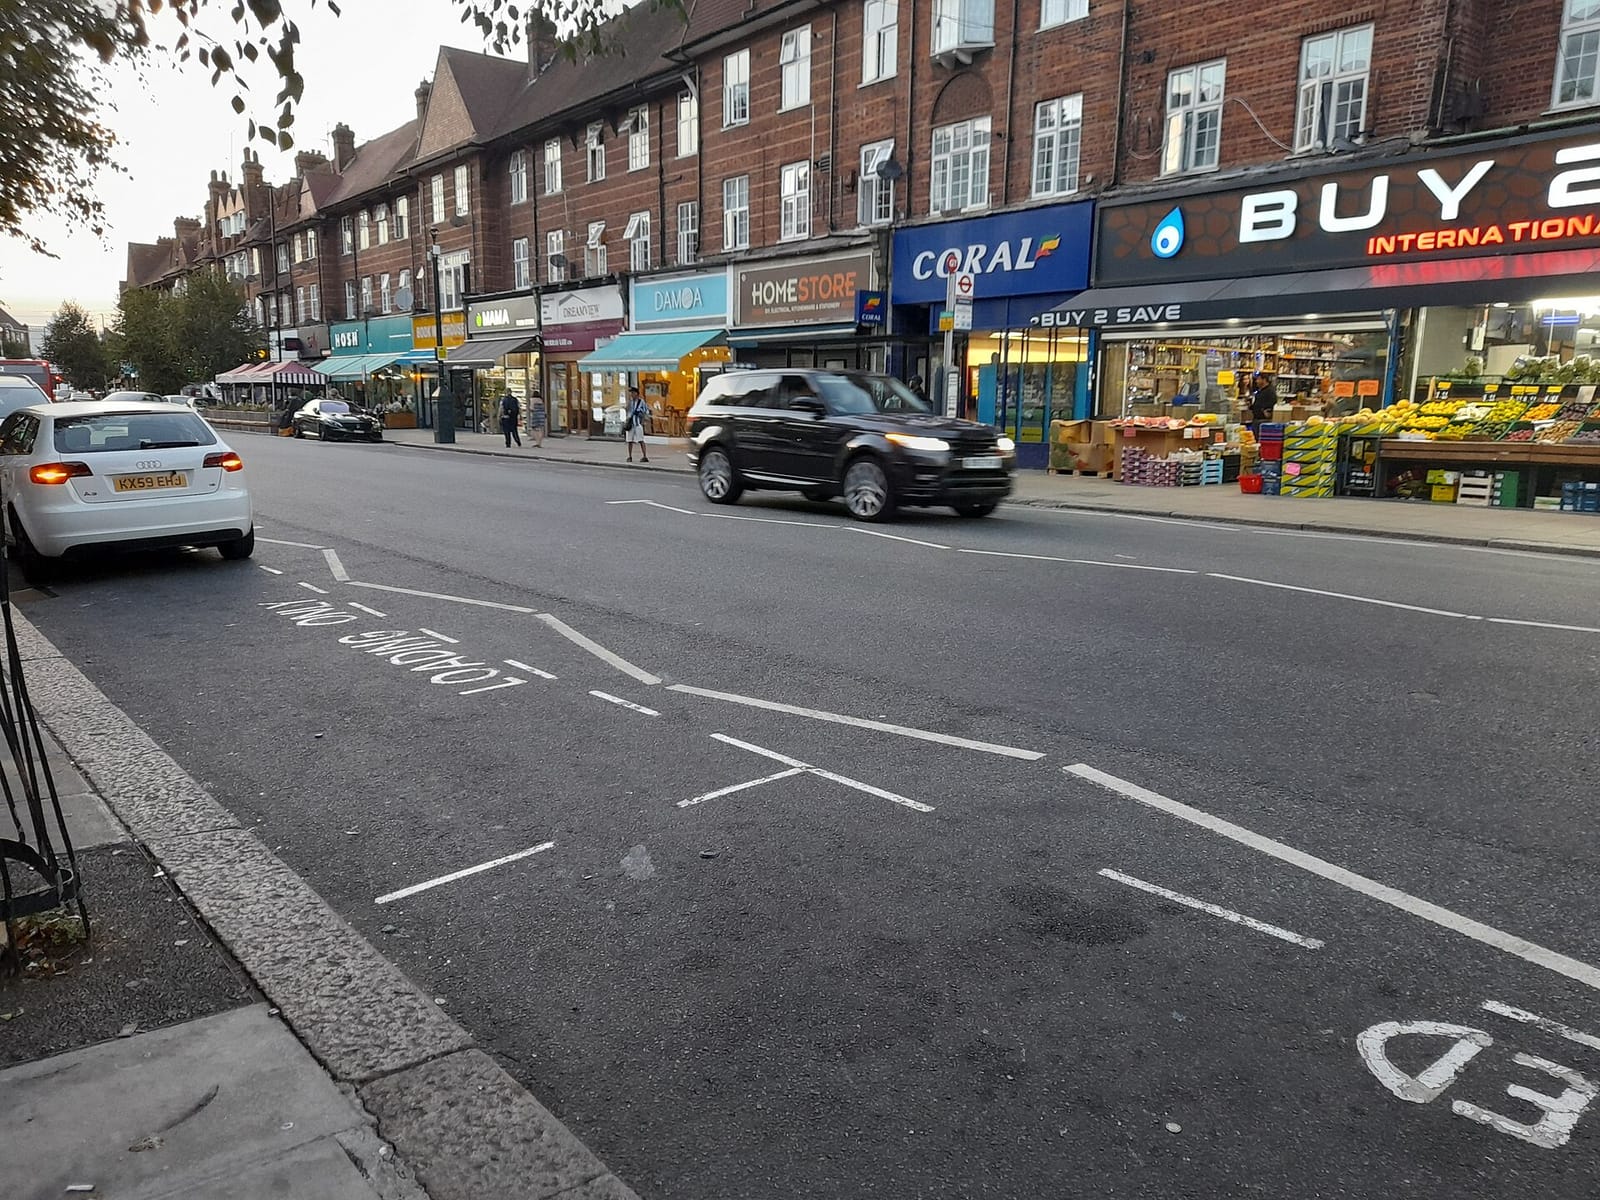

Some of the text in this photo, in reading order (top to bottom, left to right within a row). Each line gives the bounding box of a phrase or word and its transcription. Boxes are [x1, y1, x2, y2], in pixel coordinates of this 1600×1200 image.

[1239, 160, 1496, 244] BUY
[1367, 214, 1600, 256] INTERNATION
[912, 236, 1036, 281] CORAL
[654, 287, 703, 312] DAMOA
[1041, 304, 1181, 328] BUY 2 SAVE
[861, 313, 881, 322] CORAL
[119, 476, 154, 490] KX59
[257, 599, 528, 695] LOADING ONLY
